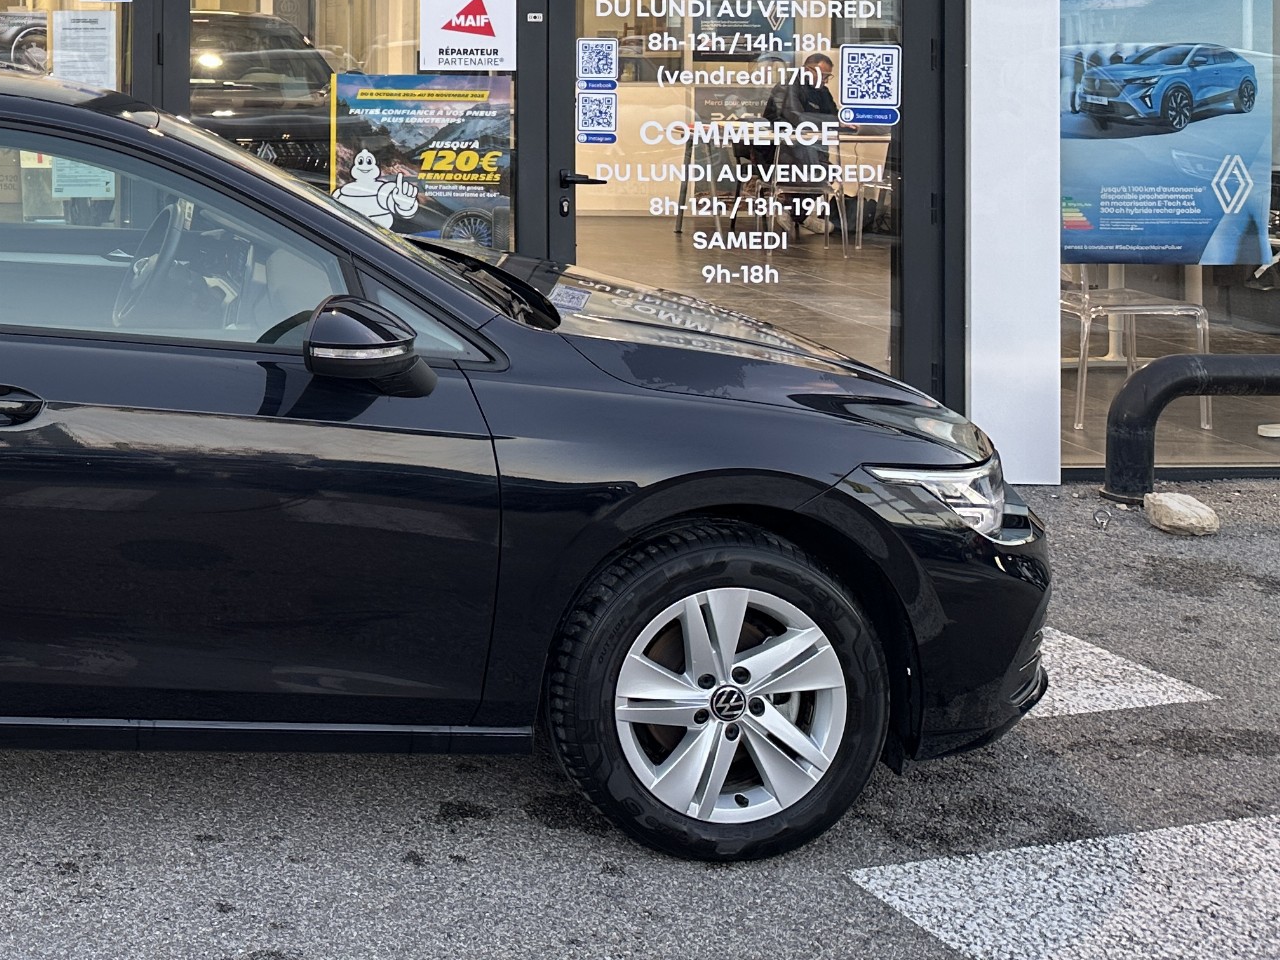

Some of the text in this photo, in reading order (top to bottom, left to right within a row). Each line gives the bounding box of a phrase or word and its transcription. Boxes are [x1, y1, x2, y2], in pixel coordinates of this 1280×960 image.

[596, 0, 882, 19] DU LUNDI AU VENDREDI
[451, 15, 489, 27] MAIF
[438, 45, 499, 56] RÉPARATEUR
[648, 32, 725, 52] 8h-12h
[744, 33, 831, 52] 14h-18h
[657, 66, 823, 89] (vendredi 17h)
[446, 109, 464, 117] VOS
[639, 120, 840, 146] COMMERCE
[429, 140, 480, 150] JUSQU'À
[420, 150, 502, 172] 120€
[418, 172, 501, 182] REMBOURSÉS
[596, 164, 883, 183] DU LUNDI AU VENDREDI
[1101, 185, 1127, 193] jusqu'à
[649, 197, 727, 216] 8h-12h
[746, 197, 830, 217] 13h-19h
[692, 231, 787, 250] SAMEDI
[702, 264, 779, 284] 9h-18h
